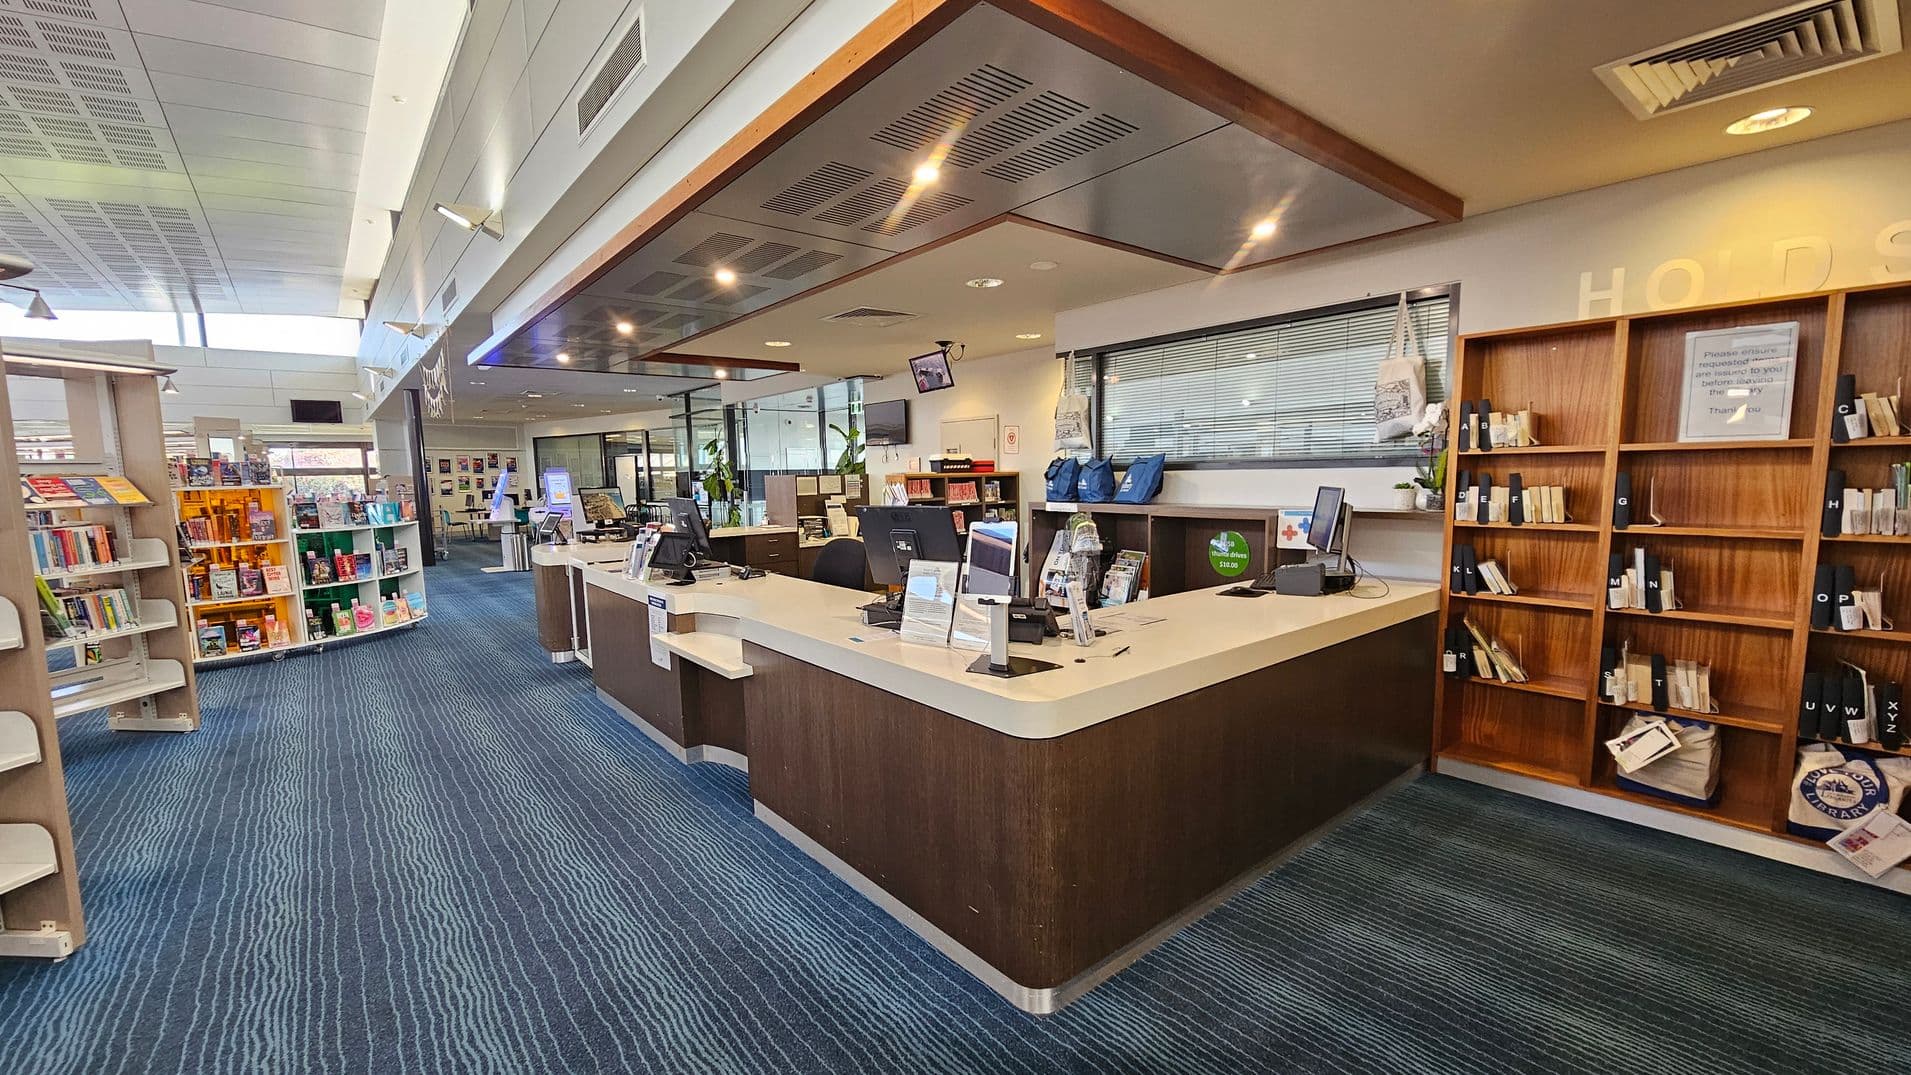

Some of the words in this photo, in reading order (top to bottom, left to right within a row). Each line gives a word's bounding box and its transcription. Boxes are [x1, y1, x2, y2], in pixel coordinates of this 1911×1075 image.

[1578, 220, 1911, 320] HOLDS
[1703, 350, 1739, 358] Please
[1741, 347, 1777, 356] ensure
[1698, 358, 1750, 369] requested
[1714, 367, 1748, 376] issued
[1763, 366, 1783, 376] you
[1701, 379, 1734, 387] before
[1838, 405, 1849, 414] C
[1618, 497, 1628, 506] G
[1828, 500, 1839, 509] H
[1611, 578, 1620, 586] M
[1649, 580, 1658, 589] N
[1839, 595, 1849, 603] P
[1604, 671, 1612, 679] S
[1655, 679, 1663, 687] T
[1805, 701, 1815, 710] U
[1825, 704, 1836, 712] V
[1844, 706, 1859, 715] W
[1805, 792, 1869, 819] LIBRARY
